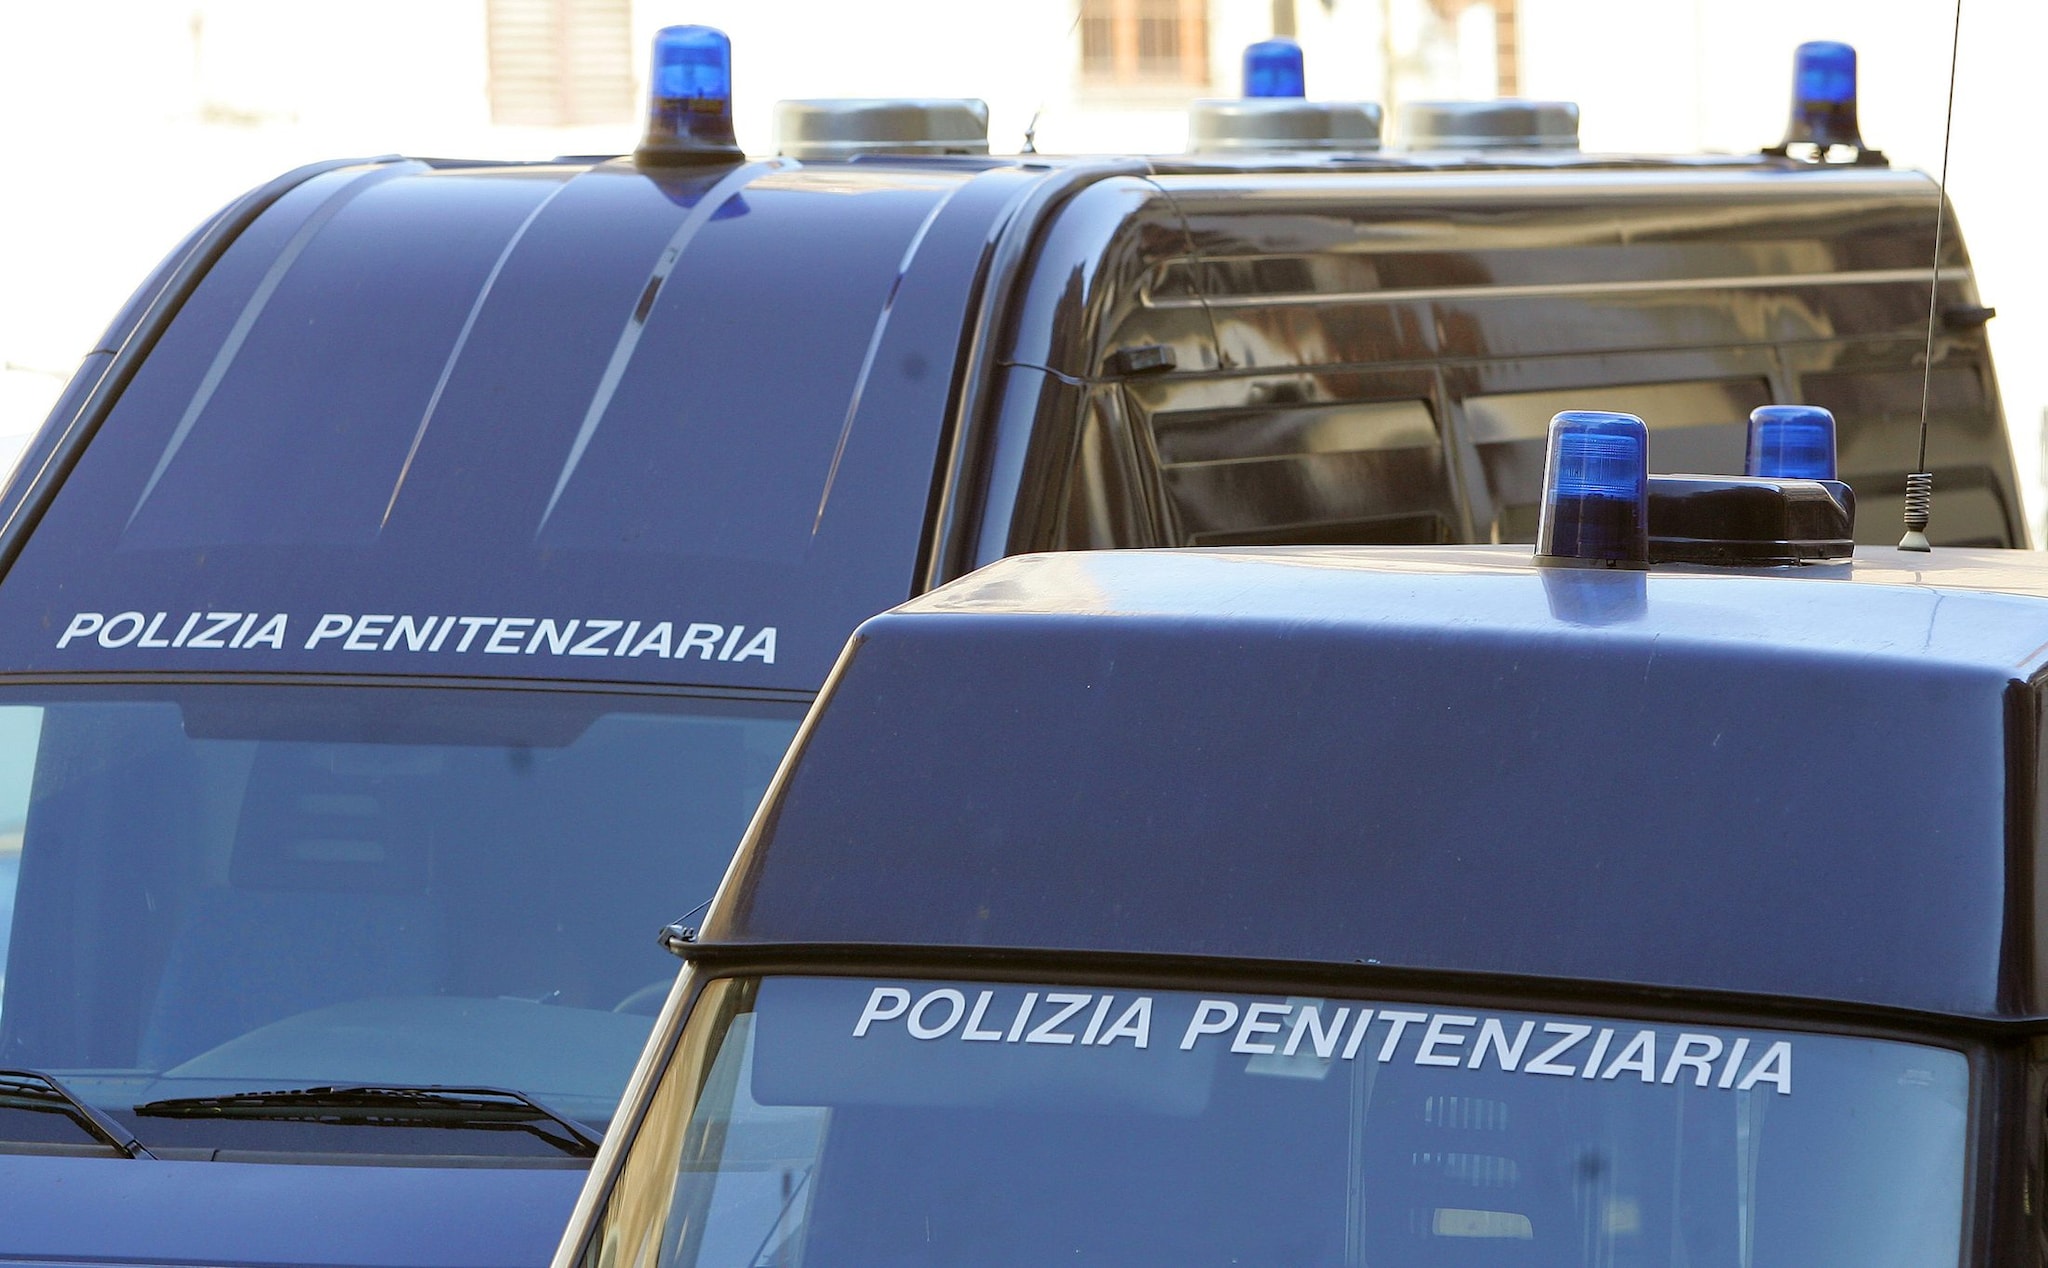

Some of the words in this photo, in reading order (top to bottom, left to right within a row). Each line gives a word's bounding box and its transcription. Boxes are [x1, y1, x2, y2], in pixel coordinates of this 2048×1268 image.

[56, 612, 288, 649] POLIZIA
[304, 614, 777, 664] PENITENZIARIA
[852, 987, 1153, 1049] POLIZIA
[1179, 999, 1792, 1095] PENITENZIARIA
